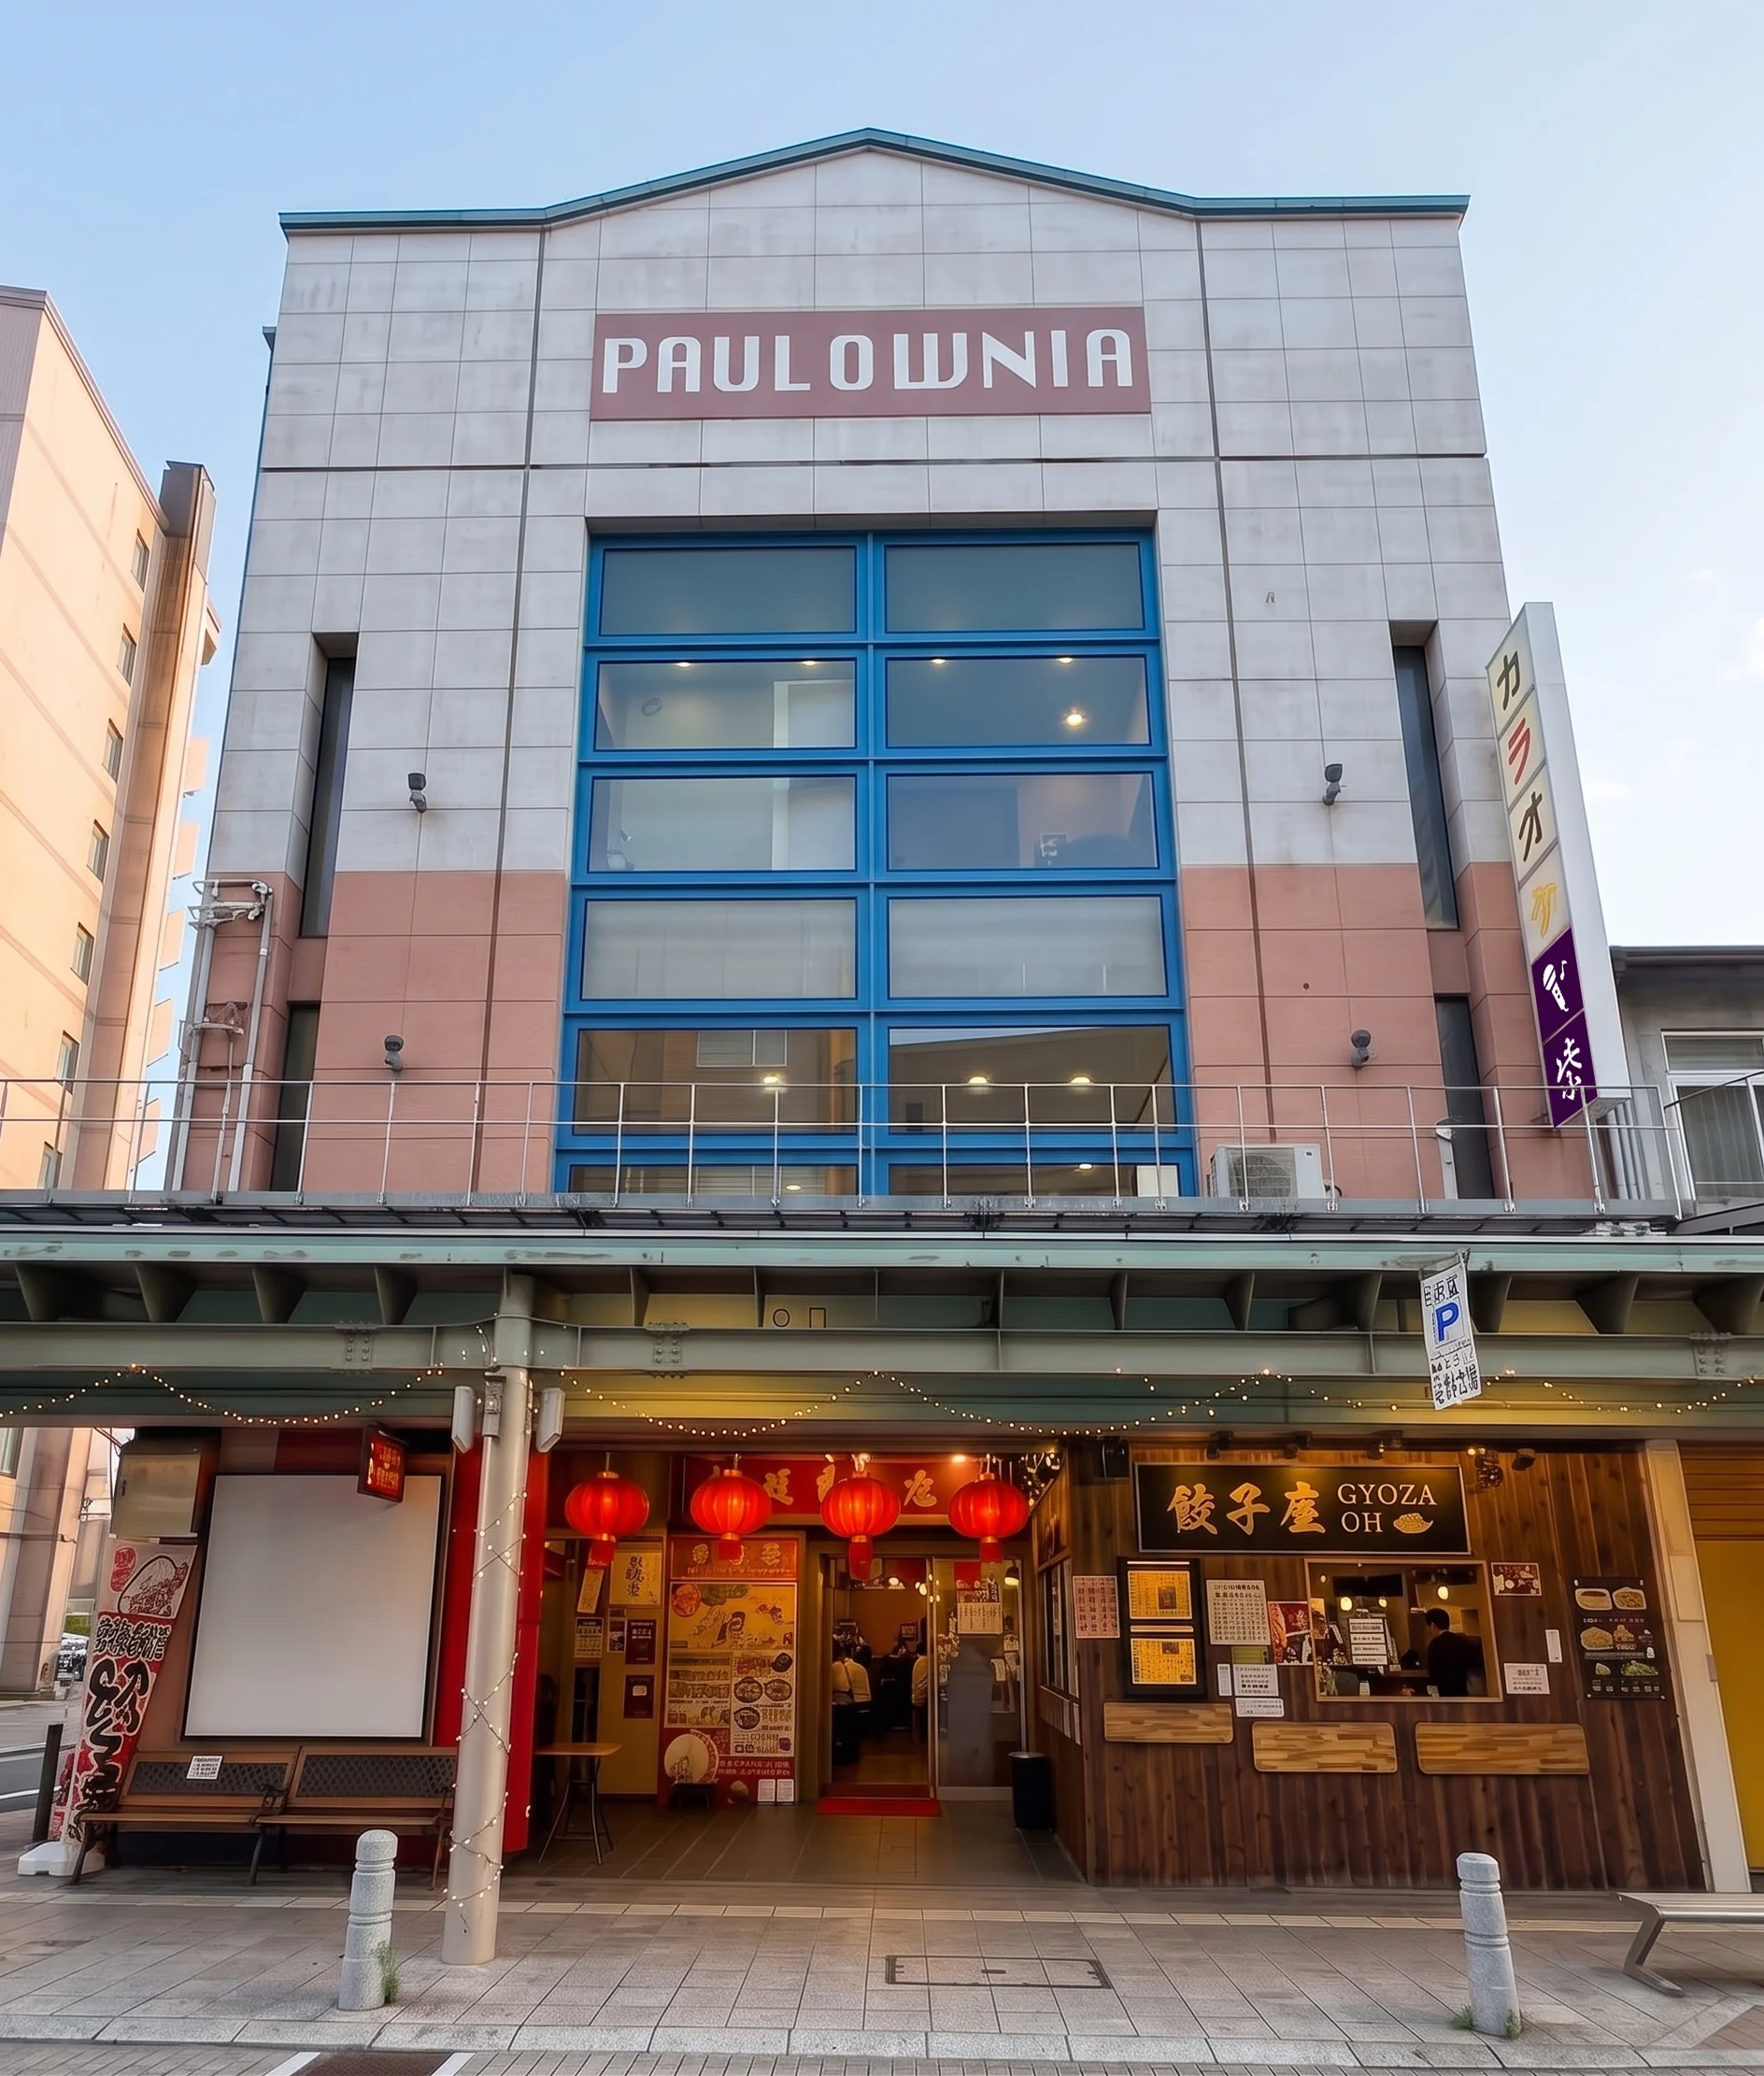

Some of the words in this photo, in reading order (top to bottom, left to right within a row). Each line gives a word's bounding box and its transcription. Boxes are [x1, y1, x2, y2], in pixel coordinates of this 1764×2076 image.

[602, 328, 1133, 393] PAULOWNIA
[1496, 650, 1558, 939] カラオケ
[1435, 1301, 1459, 1343] P
[1337, 1484, 1438, 1506] GYOZA
[1341, 1511, 1384, 1533] OH
